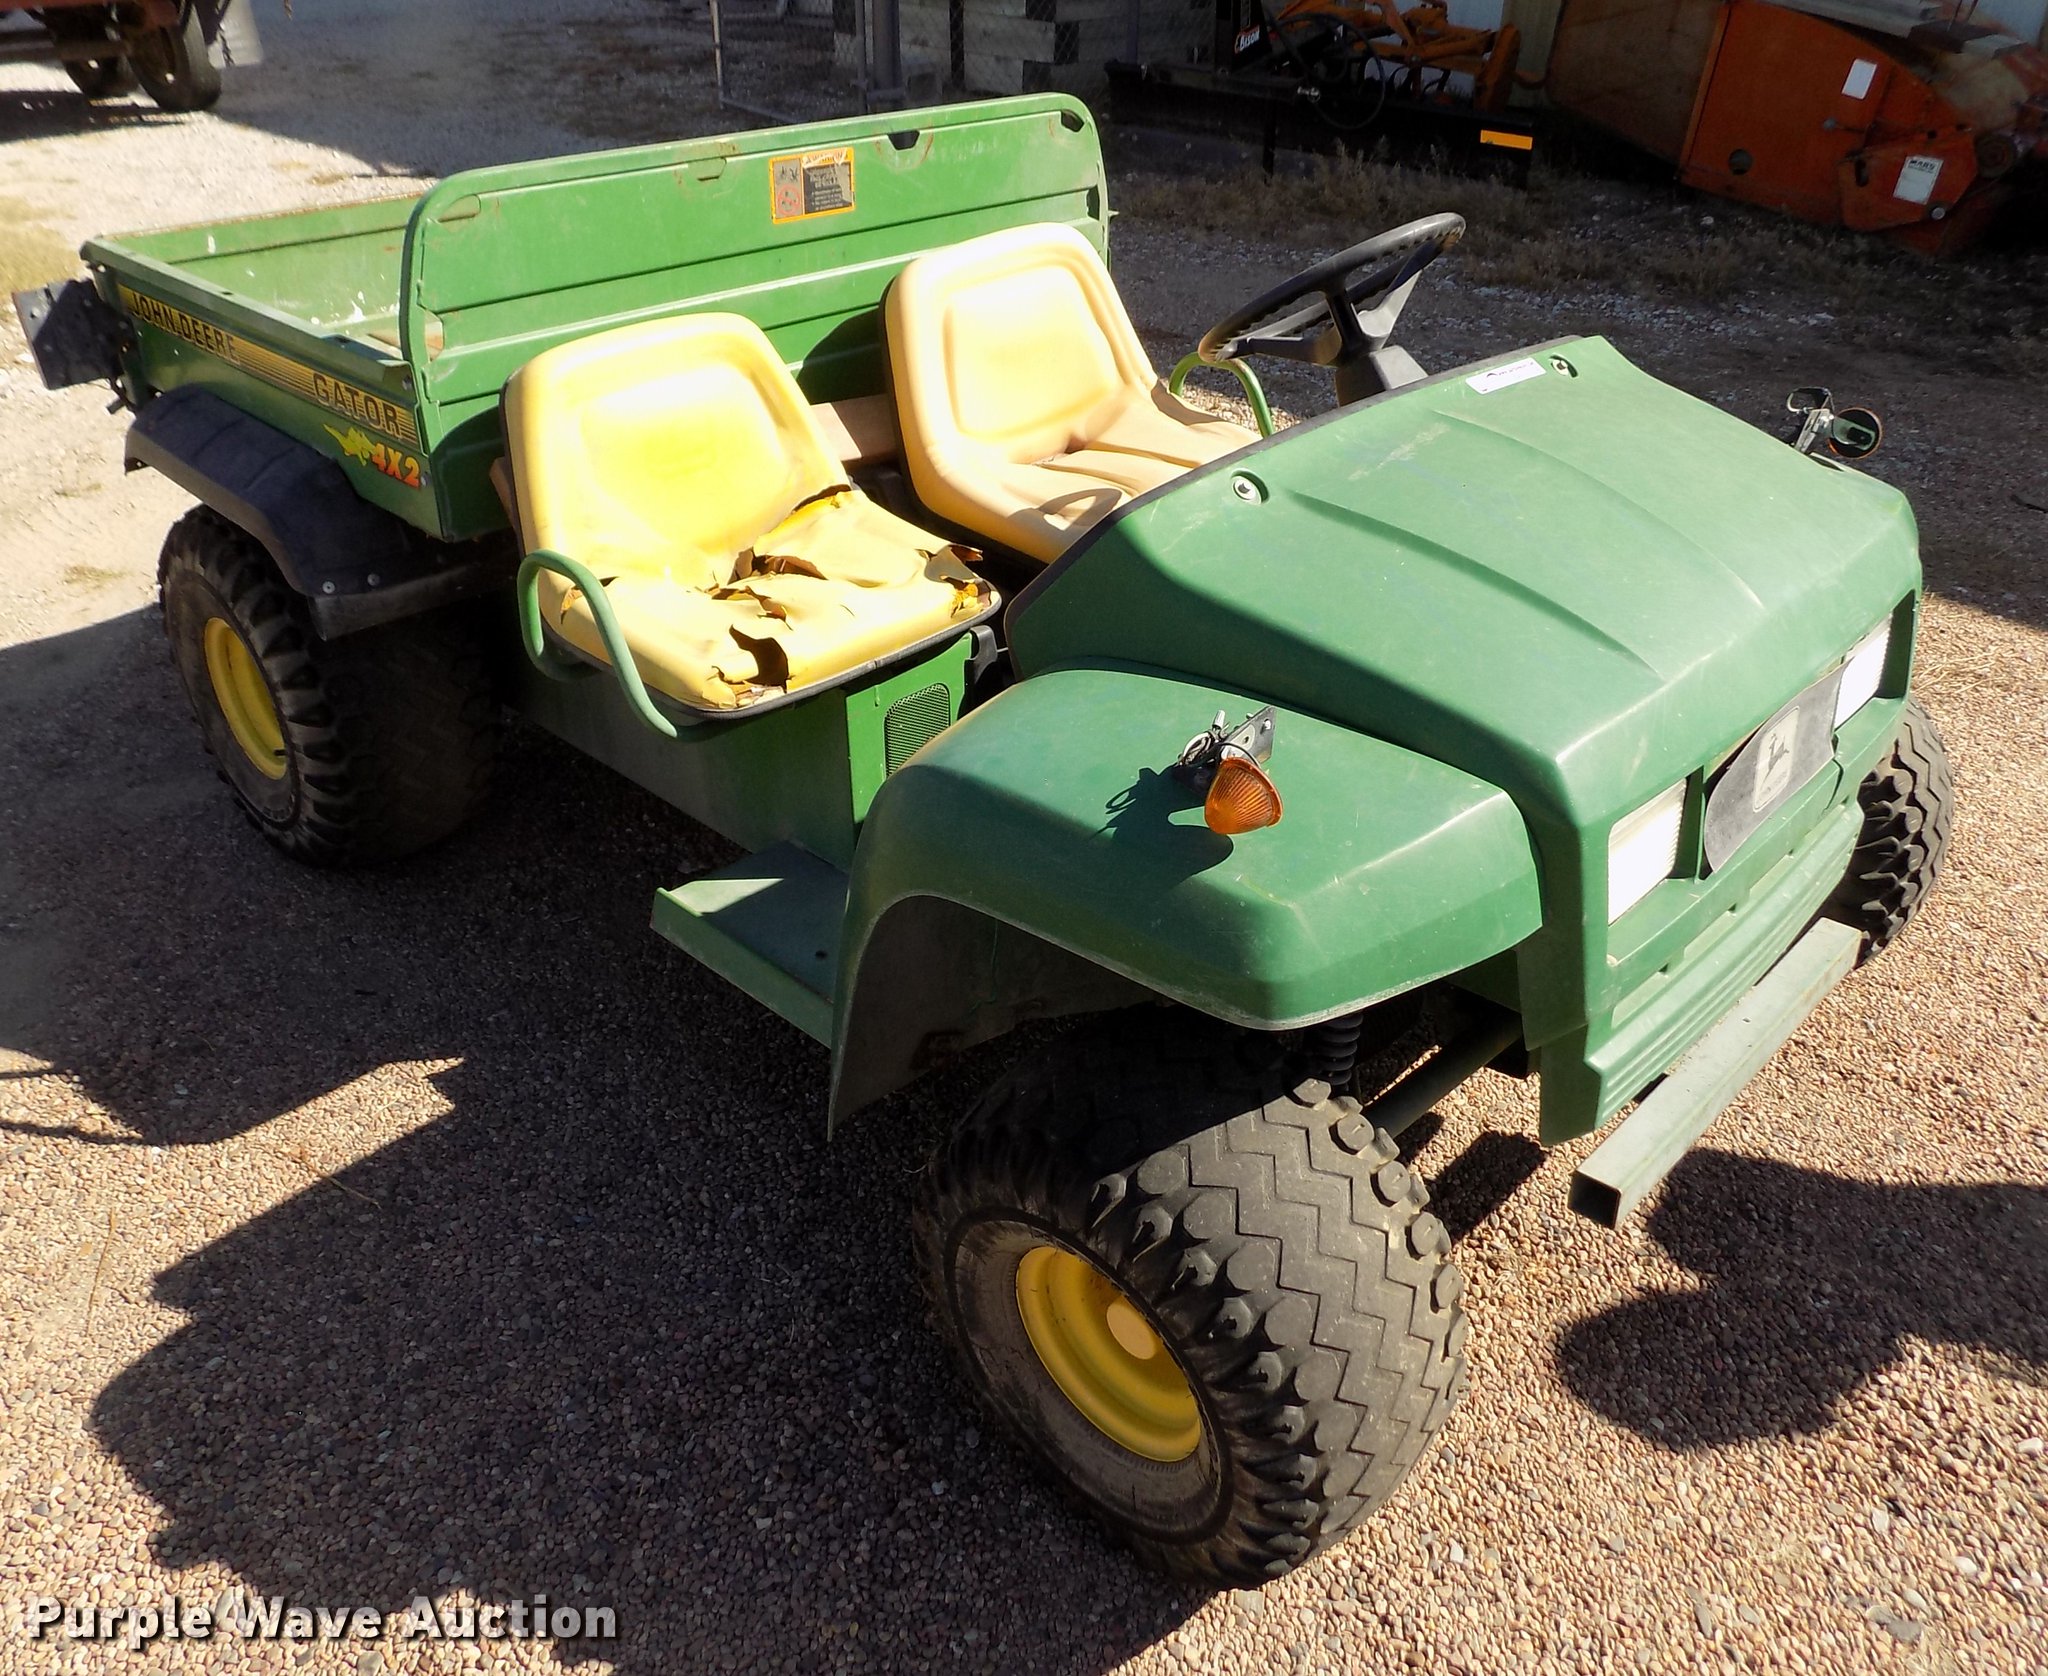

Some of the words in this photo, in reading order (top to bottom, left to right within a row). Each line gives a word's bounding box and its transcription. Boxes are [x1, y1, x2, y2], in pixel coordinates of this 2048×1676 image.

[132, 292, 179, 336] JOHN
[178, 313, 240, 366] DEERE
[313, 373, 403, 440] GATOR
[372, 442, 420, 488] 4X2
